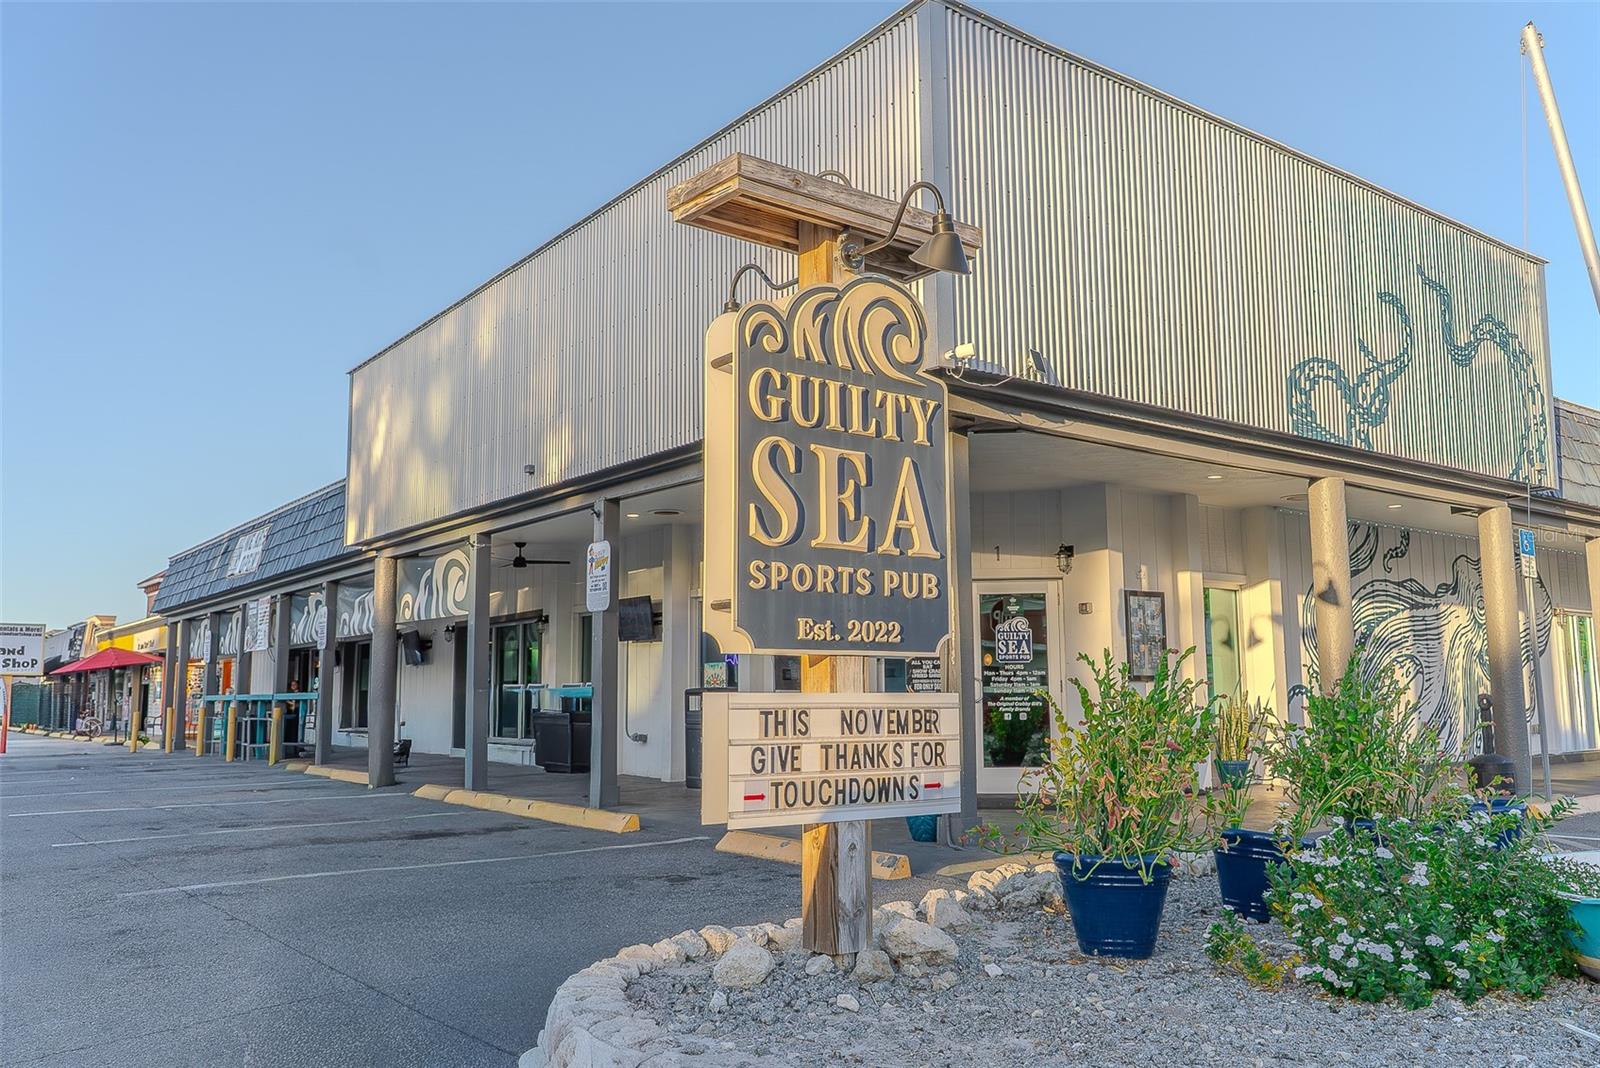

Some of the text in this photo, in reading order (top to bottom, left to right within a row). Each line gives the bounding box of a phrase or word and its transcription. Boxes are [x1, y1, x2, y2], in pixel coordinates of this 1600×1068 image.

[748, 367, 941, 446] GUILTY
[748, 435, 942, 559] SEA
[748, 559, 941, 600] SPORTS PUB
[797, 617, 902, 644] Est. 2022
[998, 632, 1030, 640] GUILTY
[998, 640, 1030, 655] SEA
[759, 708, 940, 738] THIS NOVEMBER
[751, 741, 946, 774] GIVE THANKS FOR
[770, 774, 920, 809] TOUCHDOWNS
